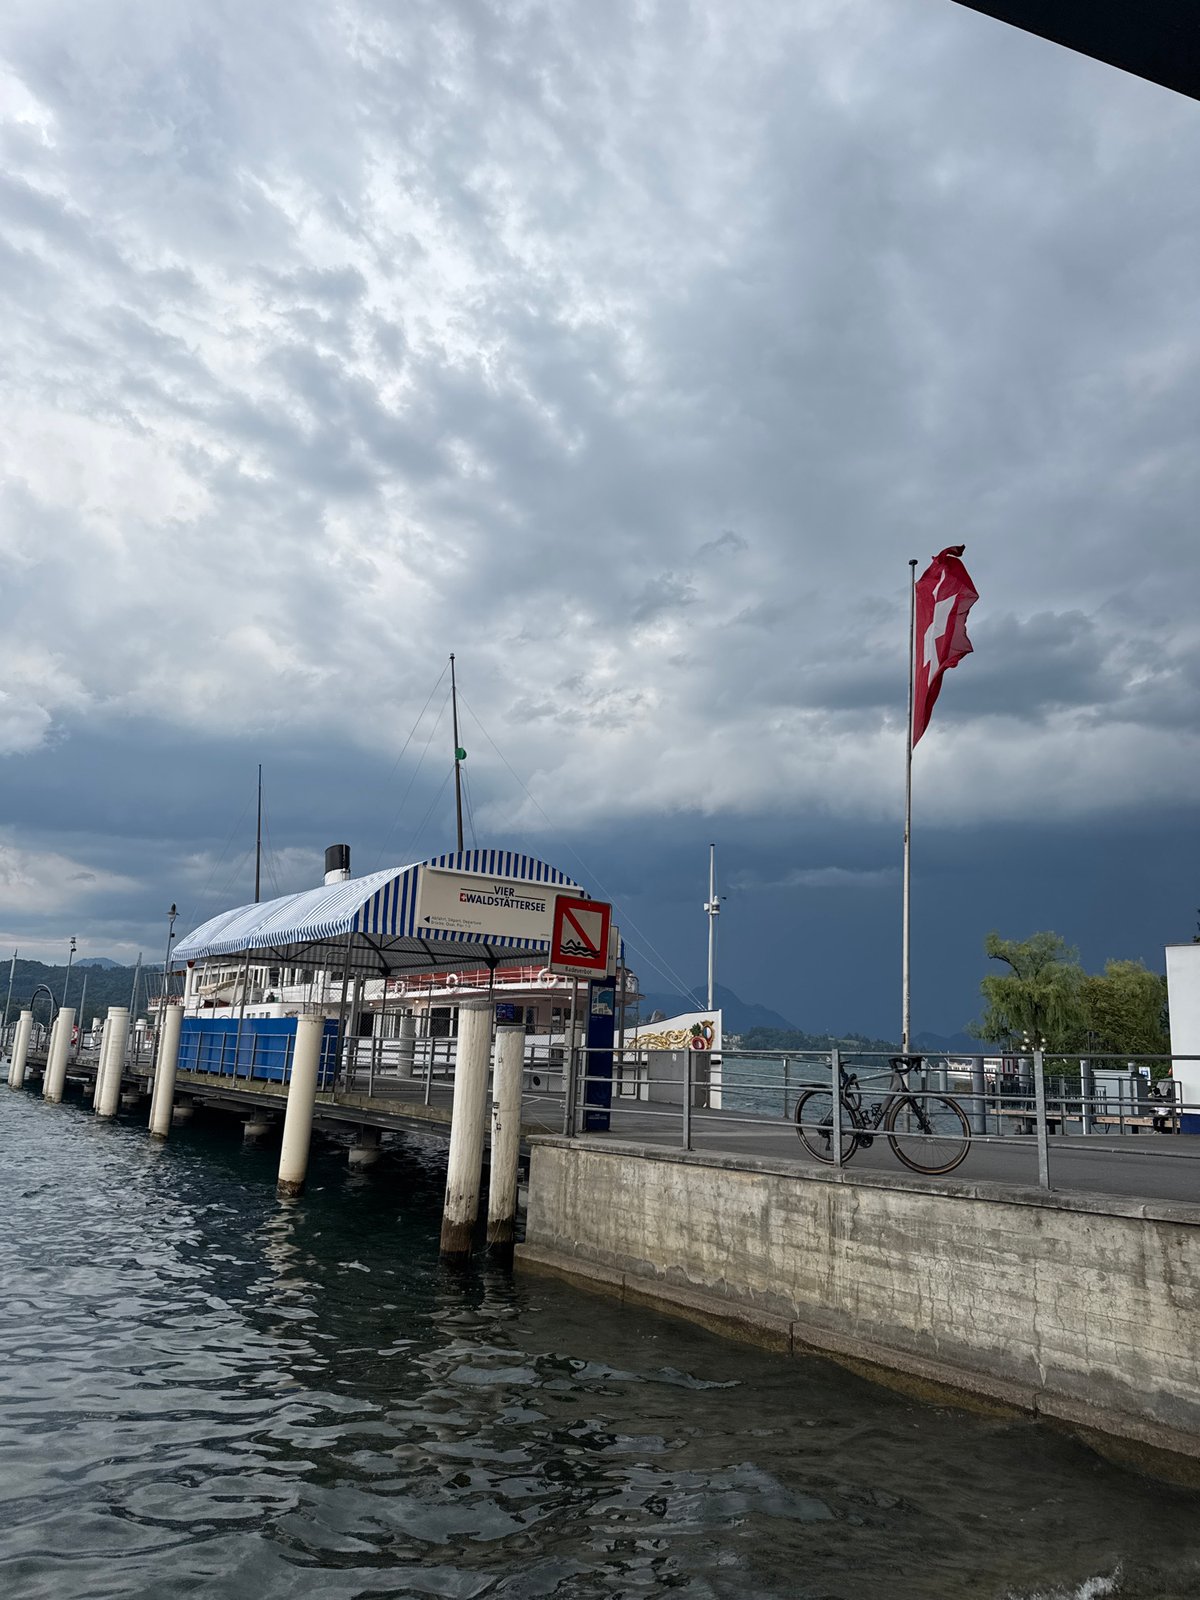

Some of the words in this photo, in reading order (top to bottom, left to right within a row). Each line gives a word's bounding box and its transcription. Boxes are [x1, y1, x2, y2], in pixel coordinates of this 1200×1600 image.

[494, 885, 515, 897] VIER
[466, 893, 546, 912] WALDSTÄTTERSEE
[565, 966, 592, 975] Badeverbot
